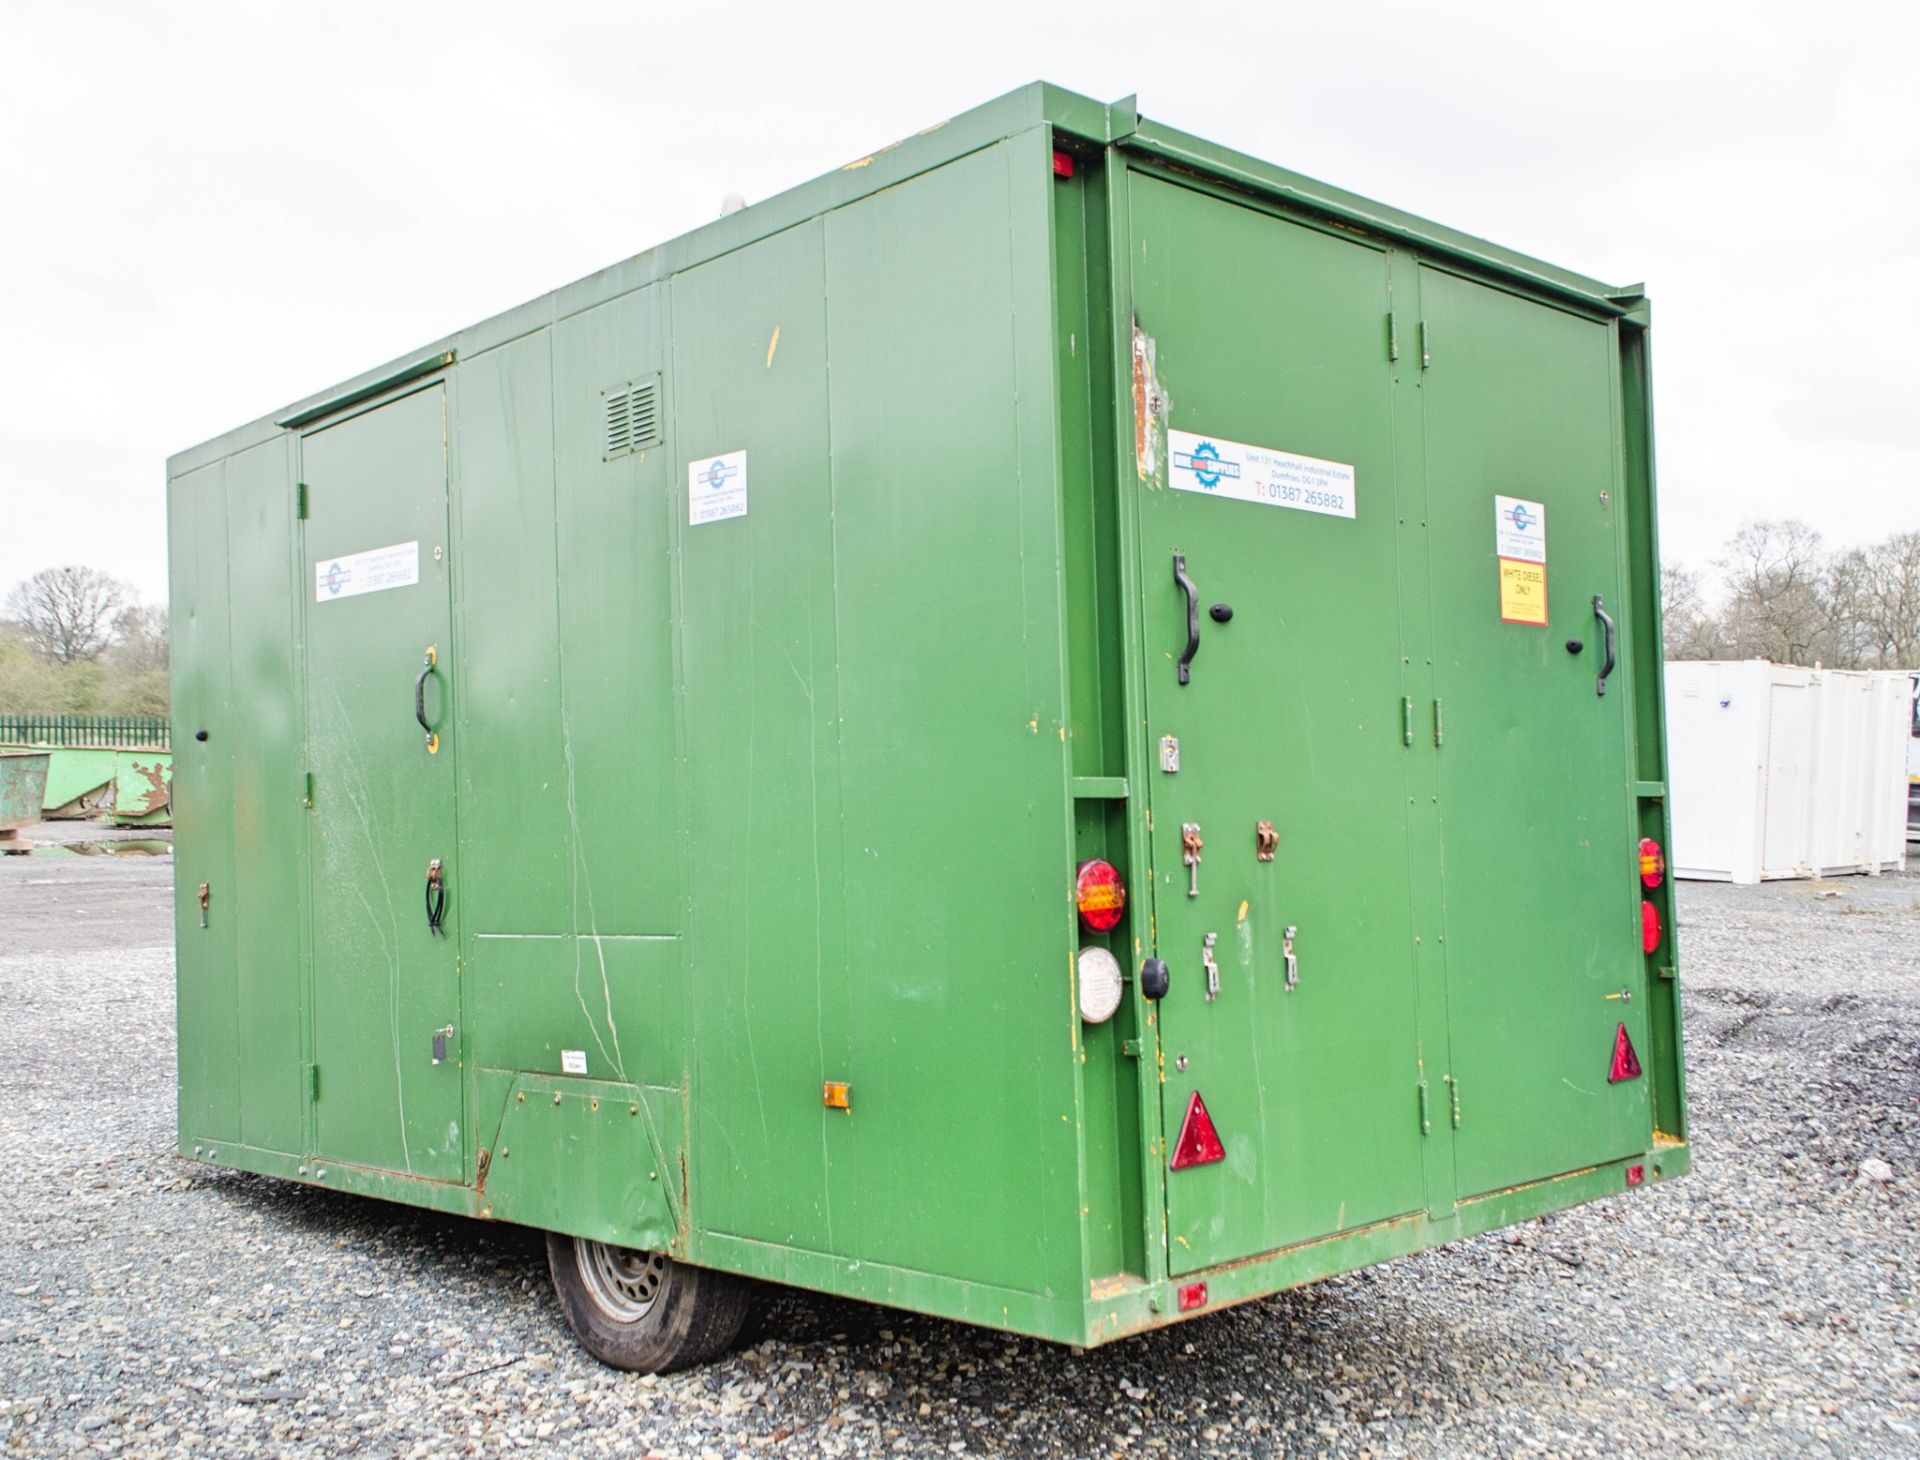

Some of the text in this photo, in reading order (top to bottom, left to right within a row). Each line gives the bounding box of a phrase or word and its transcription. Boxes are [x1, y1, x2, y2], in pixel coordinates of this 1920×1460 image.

[1245, 453, 1260, 463] Unit
[1273, 456, 1303, 471] Heathhall
[1303, 464, 1332, 476] Industrial
[1332, 469, 1350, 480] Estate
[1254, 480, 1344, 510] T: 01387 265882
[1503, 568, 1543, 583] WHITE DIESEL
[1515, 583, 1531, 596] ONLY
